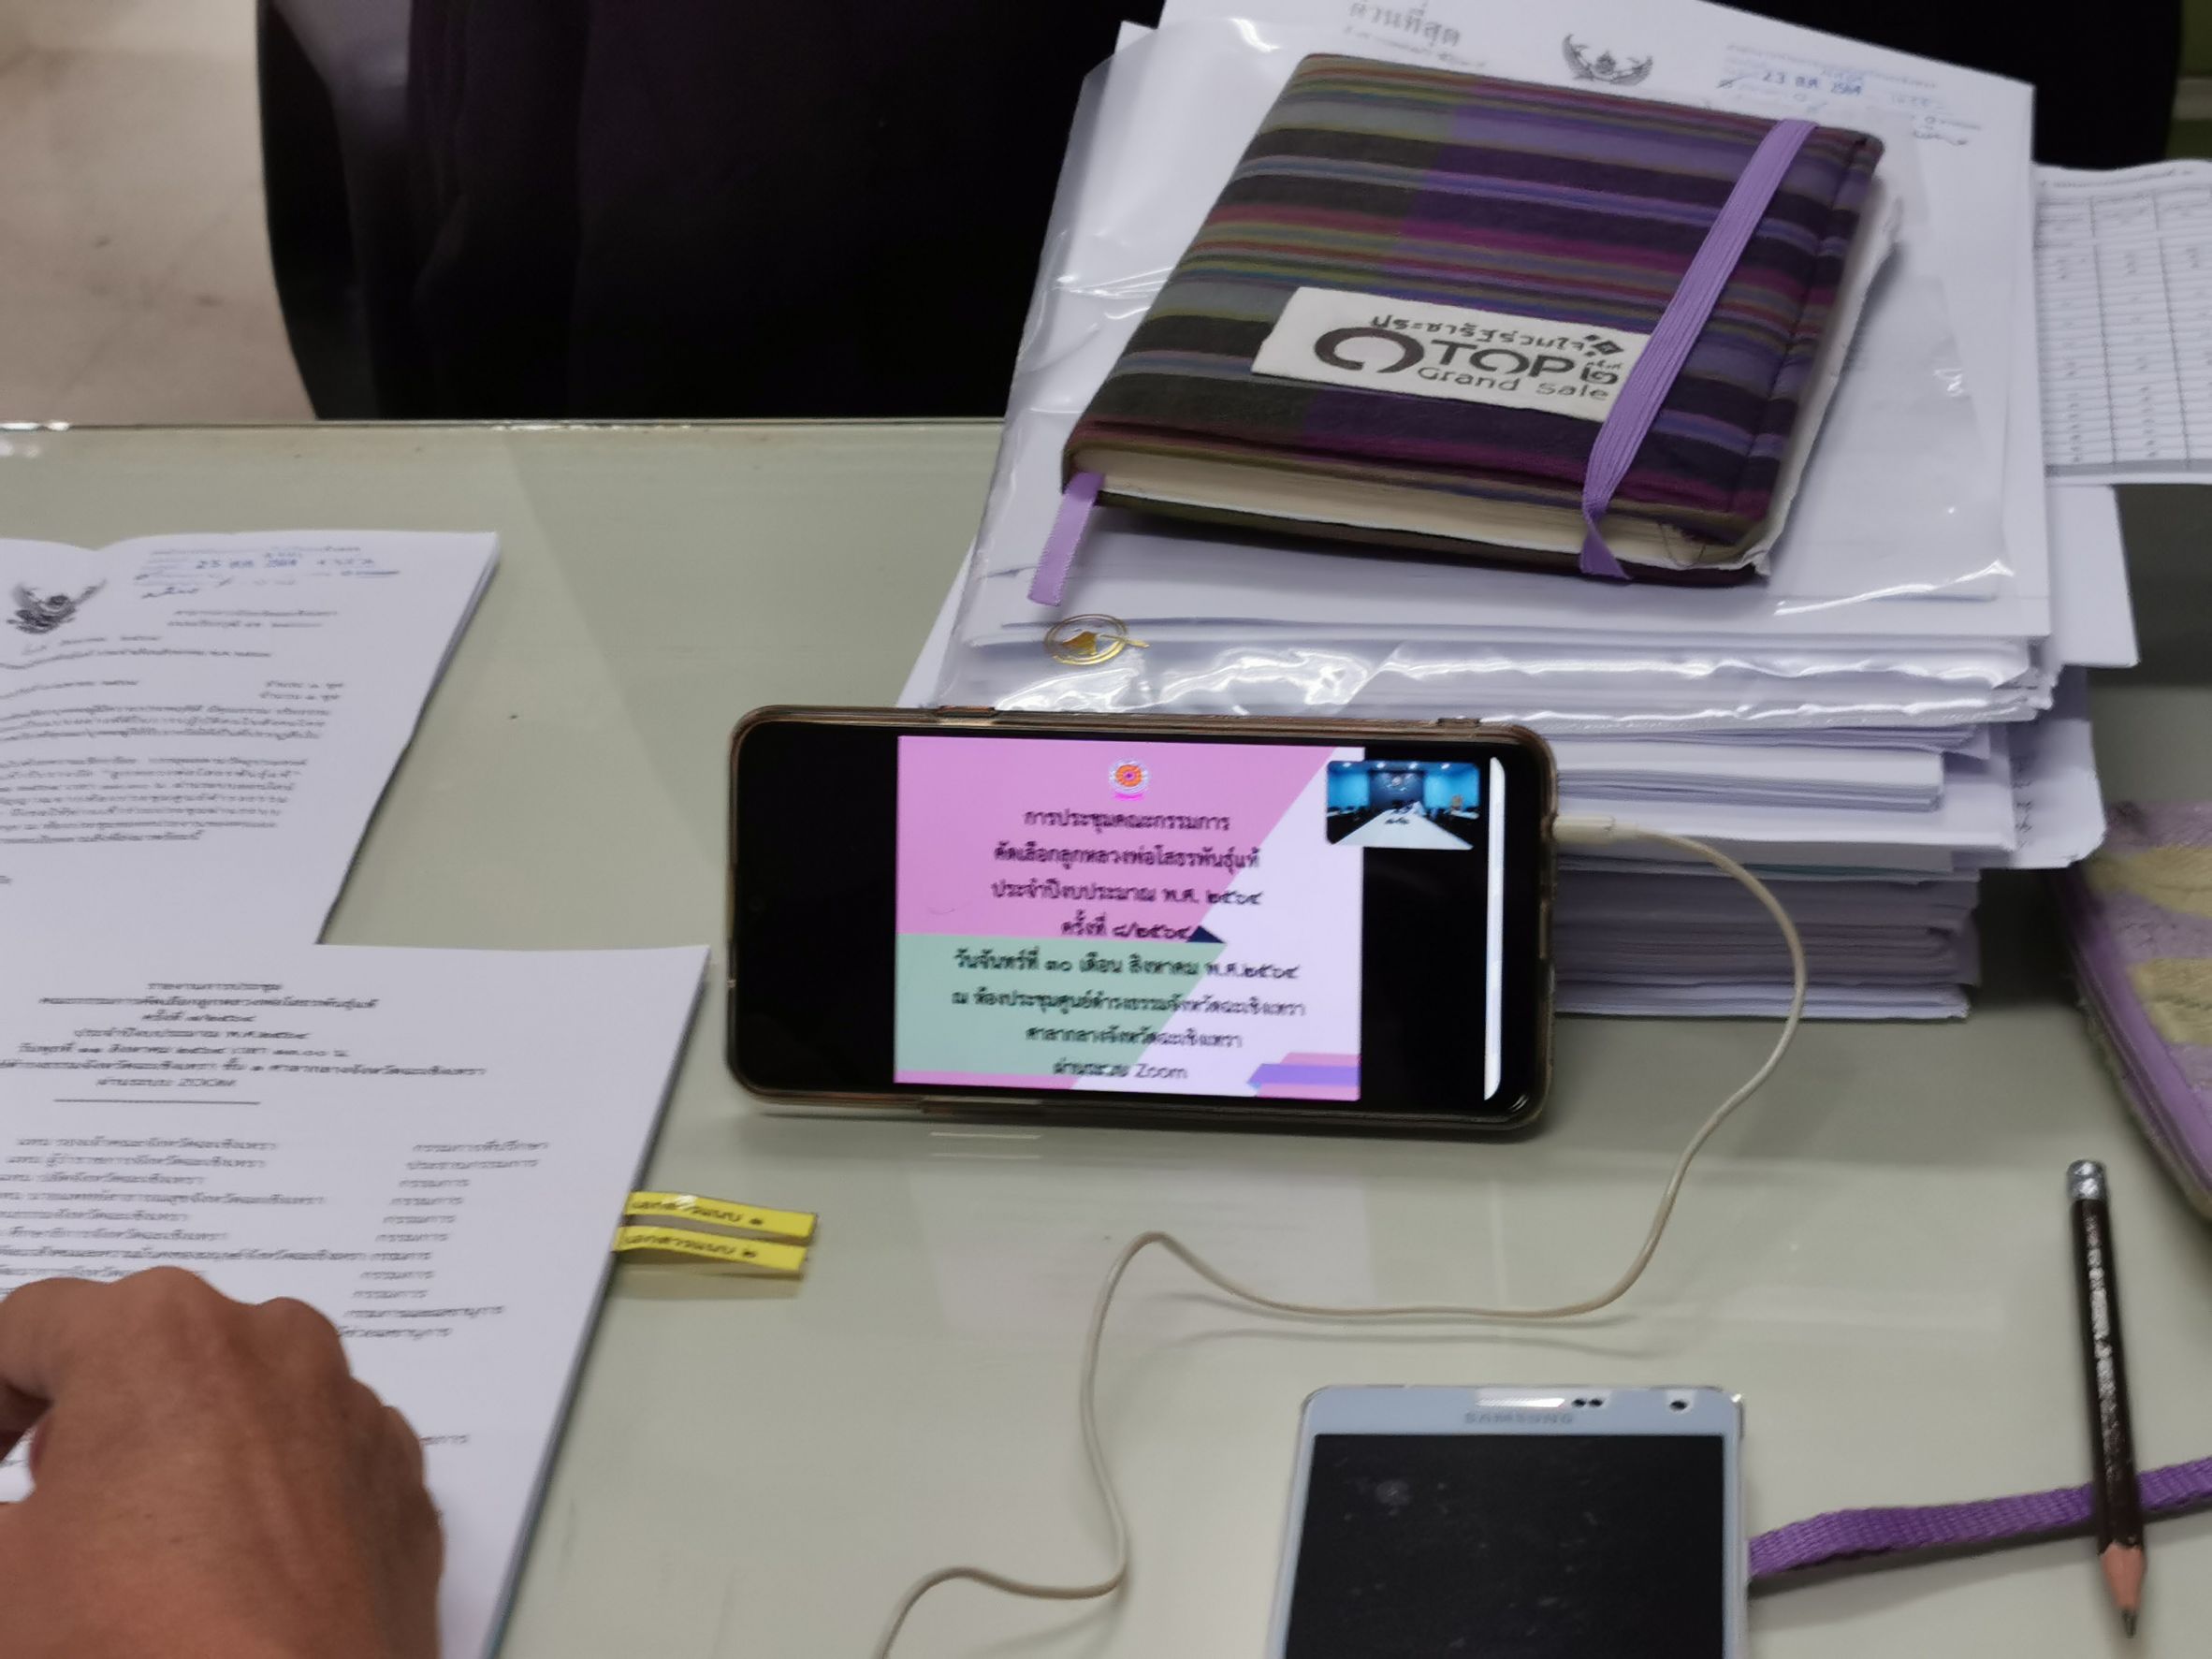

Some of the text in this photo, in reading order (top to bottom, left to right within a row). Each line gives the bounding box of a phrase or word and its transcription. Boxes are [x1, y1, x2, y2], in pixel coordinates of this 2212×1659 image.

[1369, 313, 1584, 352] ประชารัฐร่วมใจ
[1417, 366, 1610, 401] Grand Sale
[1024, 808, 1230, 834] การประชุมคณะกรรมการ
[1060, 908, 1108, 937] ครั้งที่
[954, 945, 1040, 970] วันจันทร์ที่
[1134, 1063, 1188, 1079] Zoom
